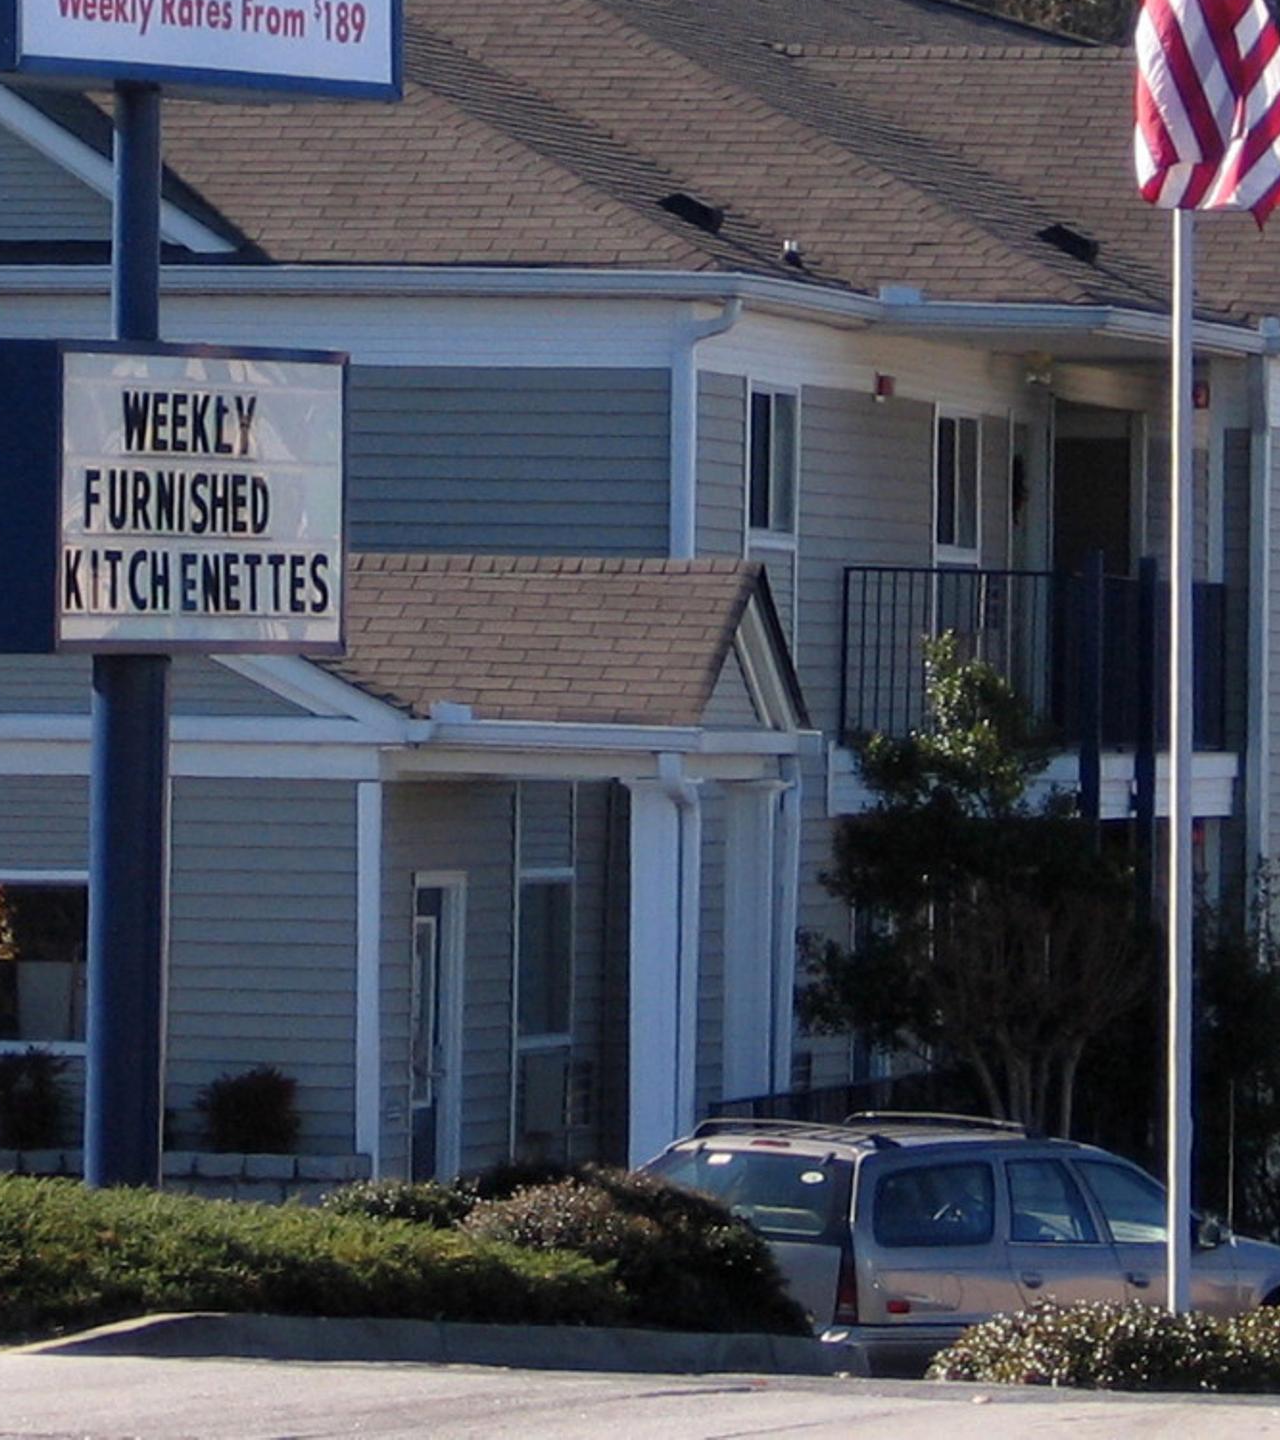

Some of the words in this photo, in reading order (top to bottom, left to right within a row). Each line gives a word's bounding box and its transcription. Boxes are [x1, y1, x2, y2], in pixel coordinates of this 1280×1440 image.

[123, 390, 257, 455] WEEKLY
[83, 469, 270, 534] FURNISHED
[64, 549, 329, 613] KITCHENETTES
